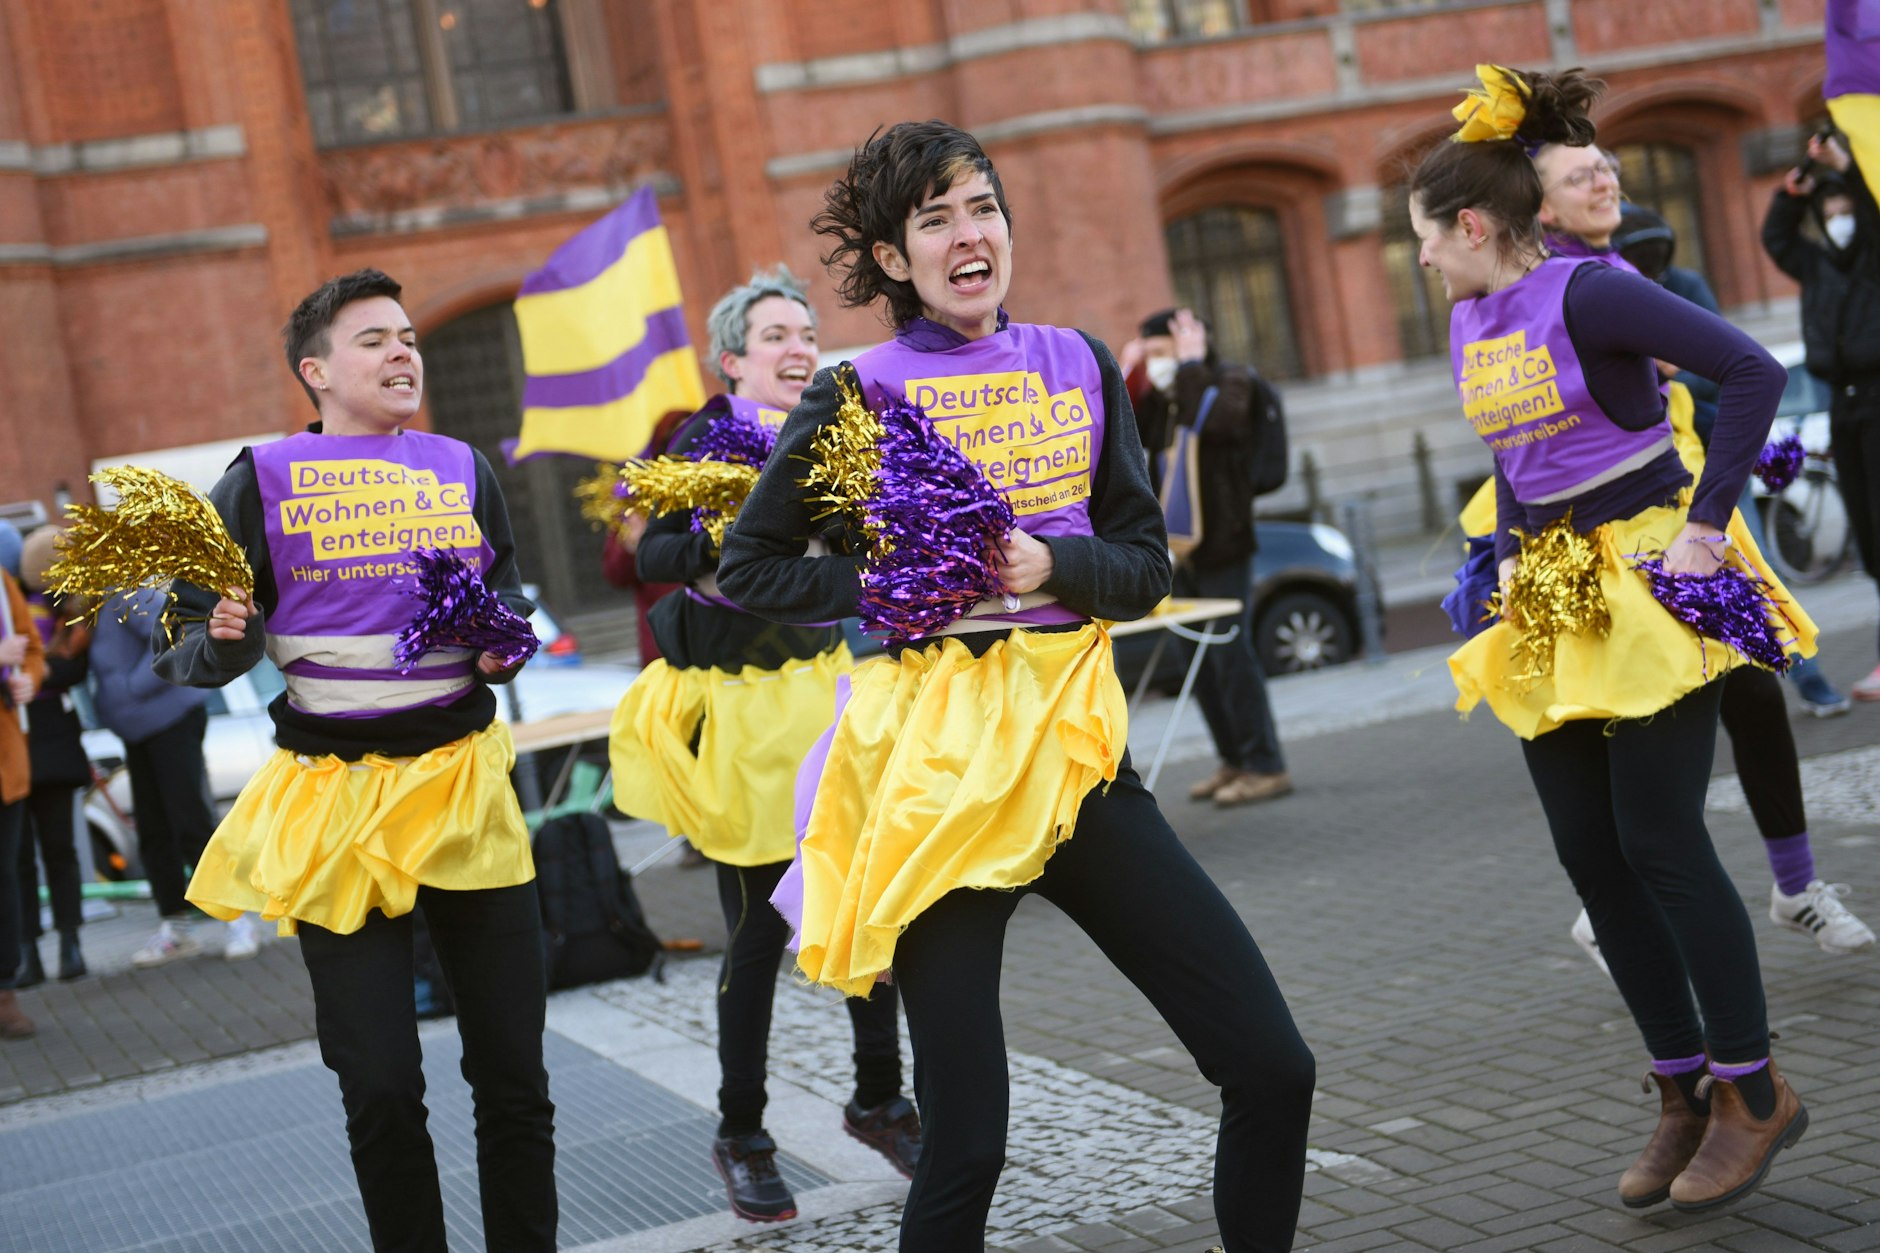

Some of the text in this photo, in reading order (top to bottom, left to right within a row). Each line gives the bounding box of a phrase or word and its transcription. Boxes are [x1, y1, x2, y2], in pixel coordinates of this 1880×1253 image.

[1465, 341, 1522, 369] utsche
[1508, 366, 1519, 387] &
[1523, 357, 1549, 379] Co
[941, 421, 1025, 451] hnen
[1051, 400, 1084, 427] Co
[1489, 415, 1581, 450] terschreiben
[975, 436, 1087, 484] eignen!
[298, 466, 430, 488] Deutsche
[286, 488, 472, 528] Wohnen & Co
[321, 520, 476, 552] enteignen!
[291, 564, 331, 582] Hier
